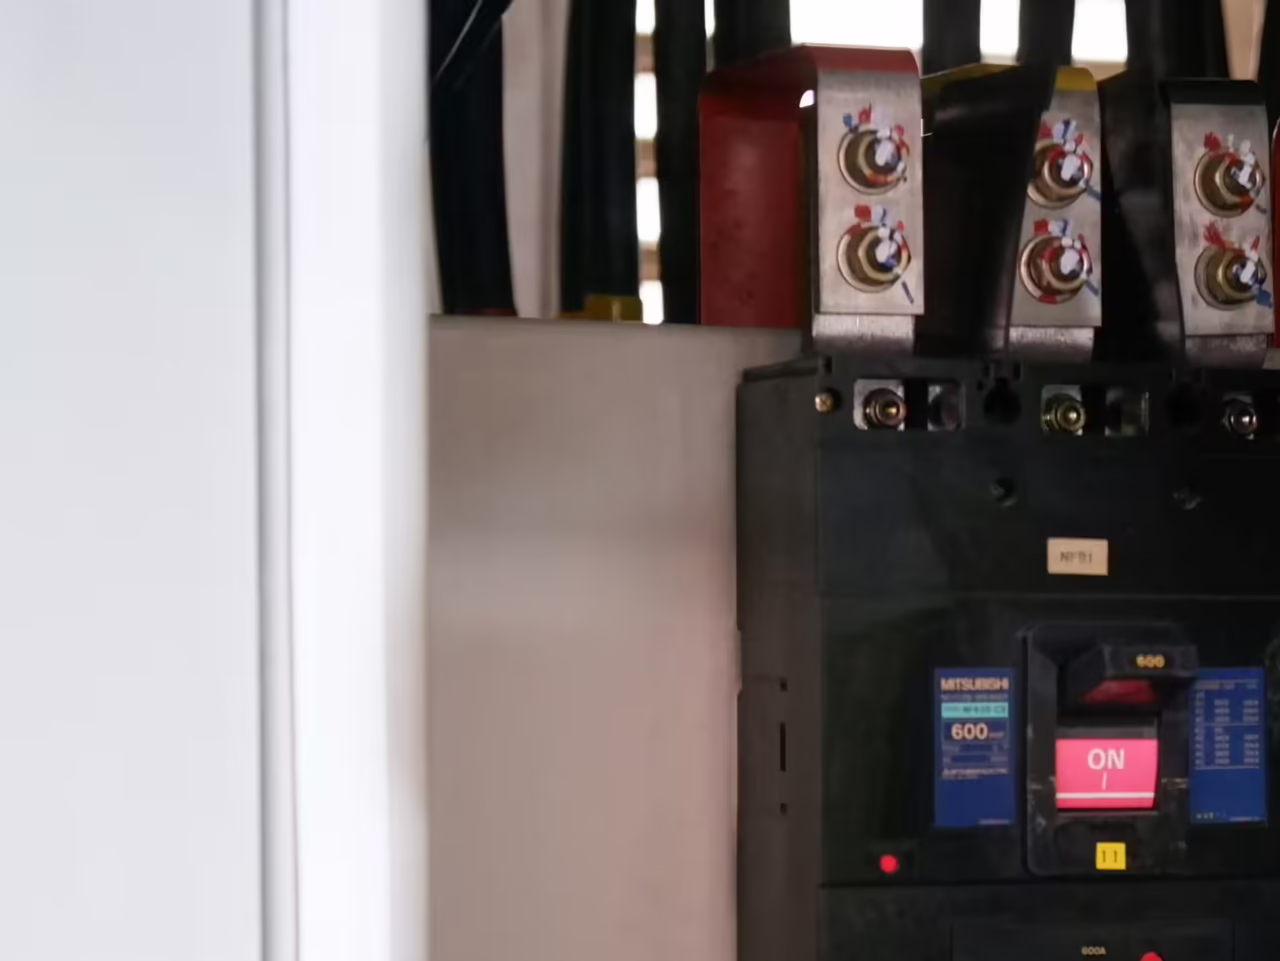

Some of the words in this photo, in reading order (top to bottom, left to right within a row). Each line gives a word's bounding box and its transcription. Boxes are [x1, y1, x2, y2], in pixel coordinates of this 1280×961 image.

[1136, 653, 1165, 668] 600
[940, 677, 1009, 691] MITSUBISHI
[951, 722, 988, 740] 600
[1087, 747, 1125, 771] ON
